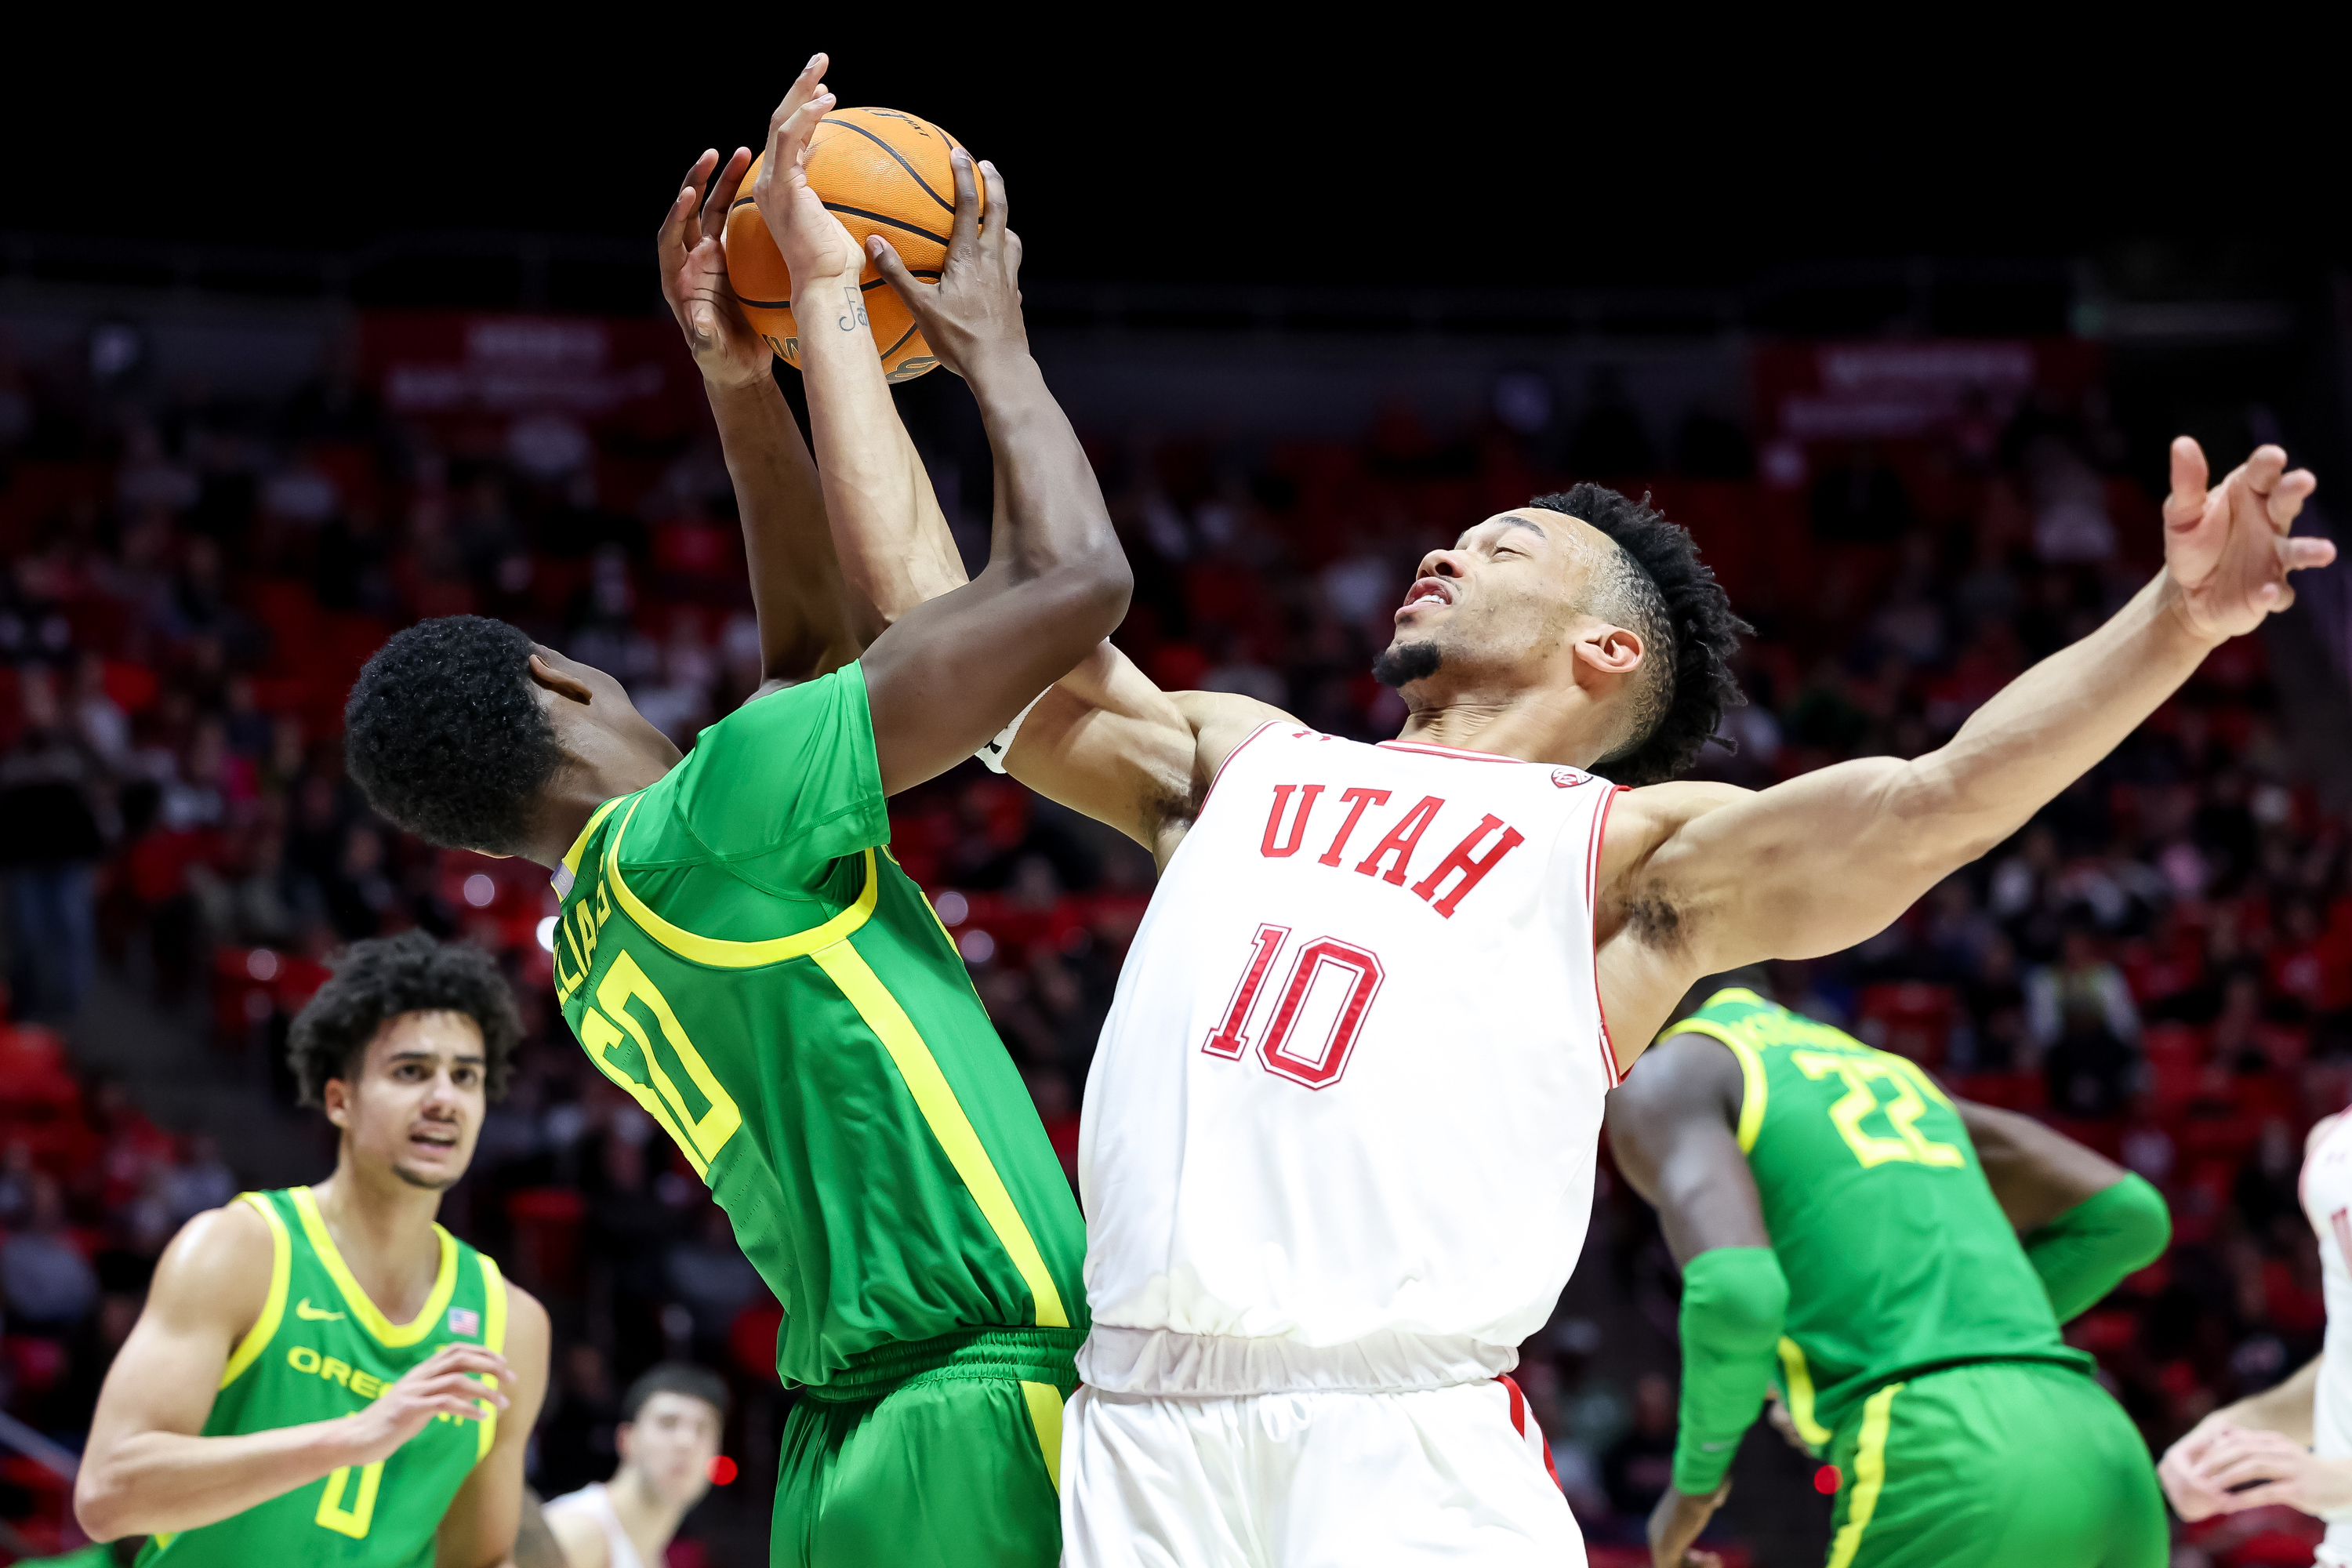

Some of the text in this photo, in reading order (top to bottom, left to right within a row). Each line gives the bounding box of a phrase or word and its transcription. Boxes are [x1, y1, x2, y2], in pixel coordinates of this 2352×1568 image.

[1260, 784, 1525, 920] UTAH
[1200, 922, 1386, 1091] 10
[1790, 1049, 1966, 1169] 22
[314, 1410, 386, 1541] 0
